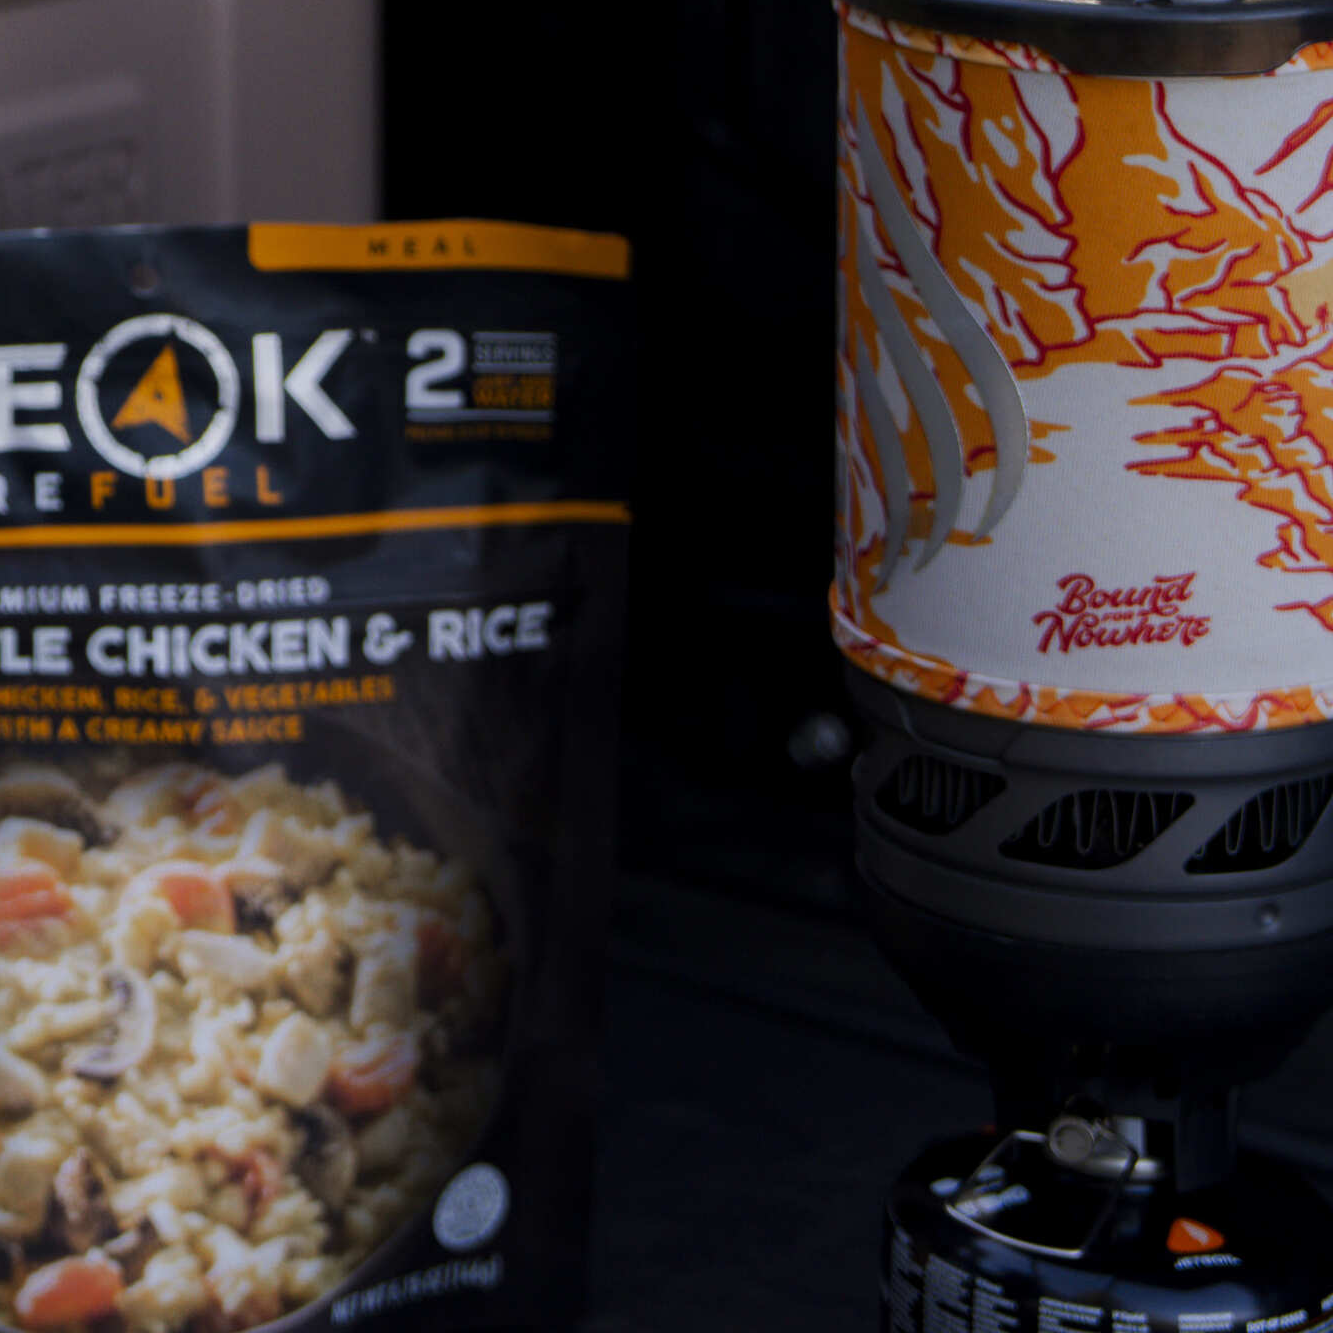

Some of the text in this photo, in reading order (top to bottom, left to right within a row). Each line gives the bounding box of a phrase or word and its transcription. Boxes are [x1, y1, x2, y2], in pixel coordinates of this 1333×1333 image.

[367, 236, 478, 258] MEAL
[404, 327, 468, 410] 2
[98, 575, 332, 614] FREEZE-DRIED
[1056, 571, 1196, 617] Bound
[85, 616, 349, 678] CHICKEN
[361, 612, 413, 663] &
[426, 601, 554, 661] RICE
[1031, 610, 1211, 654] Nowhere
[113, 685, 185, 714] RICE,
[192, 685, 219, 714] &
[223, 673, 395, 711] VEGETABLES
[56, 714, 80, 742] A
[85, 715, 206, 744] CREAMY
[211, 714, 304, 743] SAUCE
